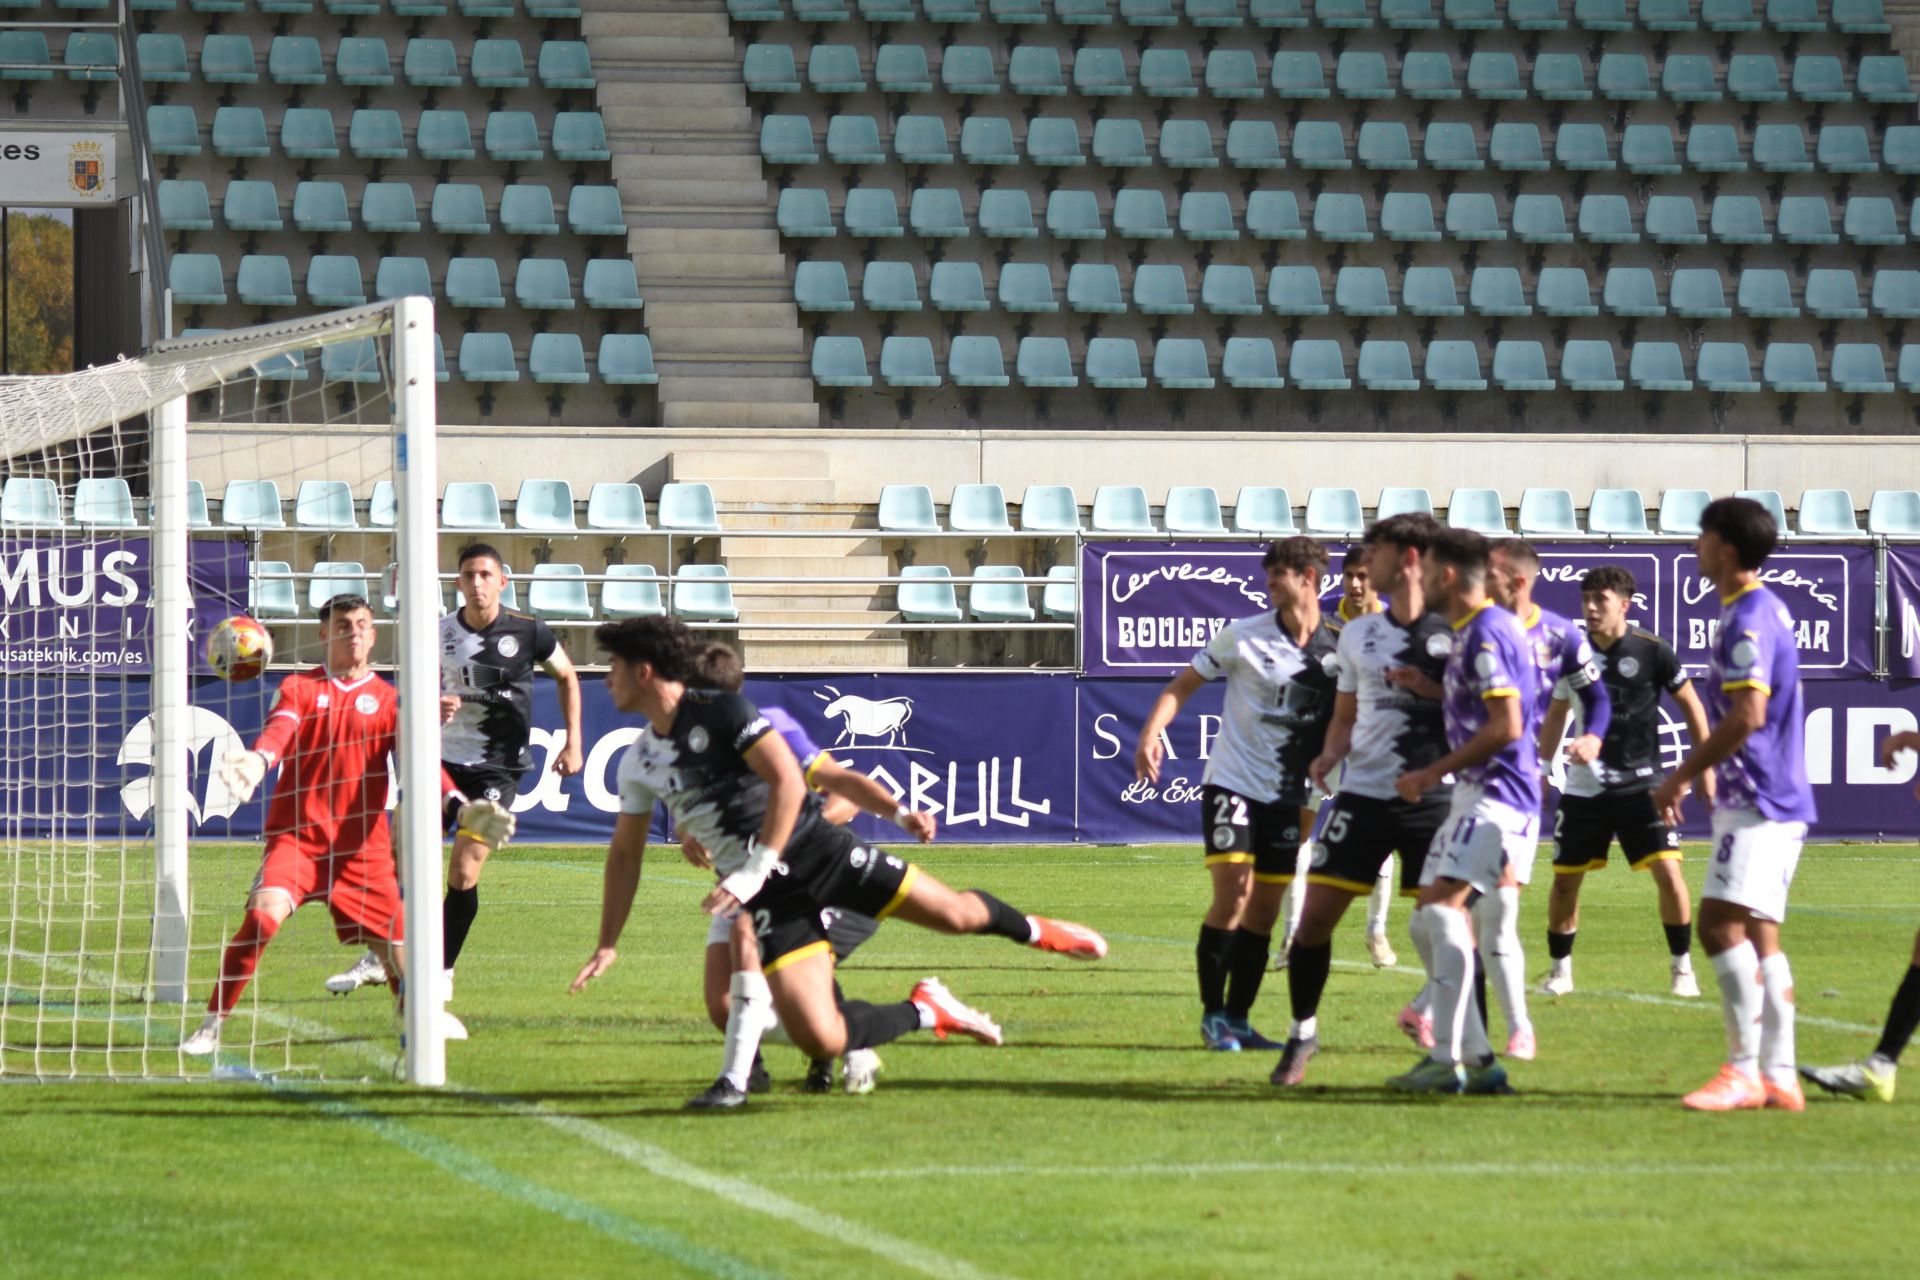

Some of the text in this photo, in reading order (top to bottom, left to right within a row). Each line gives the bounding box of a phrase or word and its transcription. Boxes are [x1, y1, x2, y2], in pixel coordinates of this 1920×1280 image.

[0, 143, 40, 161] es
[1118, 616, 1241, 648] BOULEV
[1213, 794, 1249, 826] 22
[1318, 809, 1353, 844] 15
[1451, 815, 1476, 845] 11
[1717, 833, 1735, 864] 8
